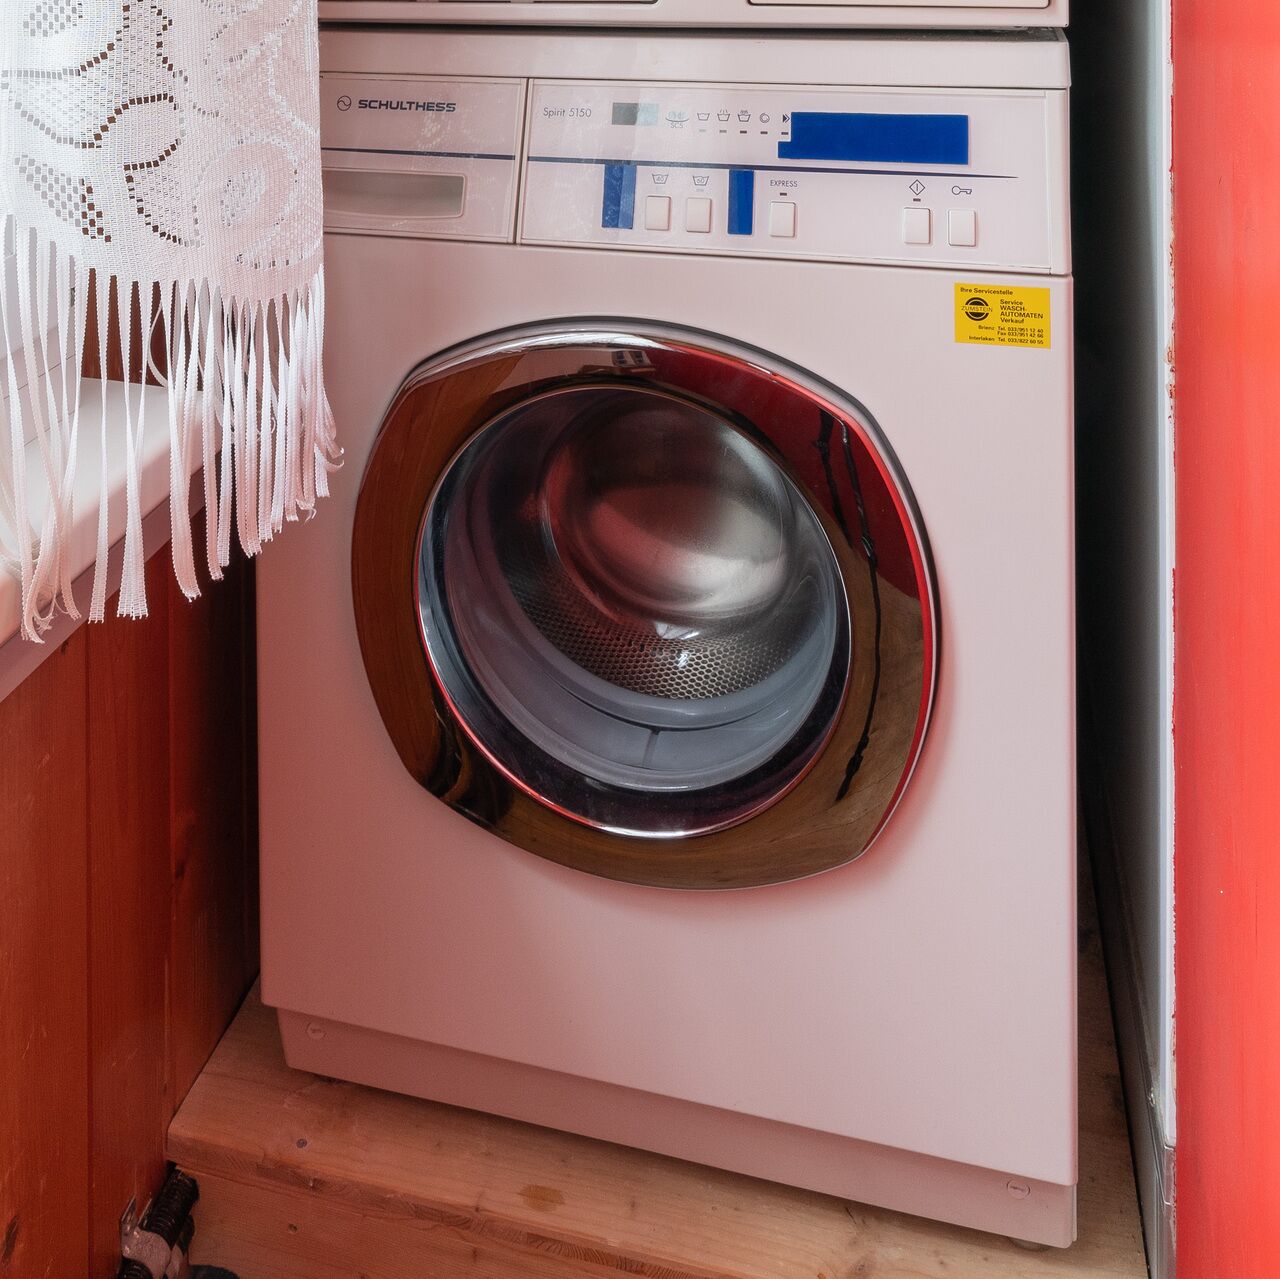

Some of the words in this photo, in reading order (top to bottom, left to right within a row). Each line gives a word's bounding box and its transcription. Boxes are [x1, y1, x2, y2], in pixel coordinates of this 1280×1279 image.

[358, 99, 457, 112] SCHULTHESS
[543, 107, 565, 118] Spirit
[568, 107, 592, 118] 5150
[770, 179, 798, 188] EXPRESS
[974, 287, 1013, 295] Servicestelle
[1000, 311, 1043, 319] AUTOMATEN
